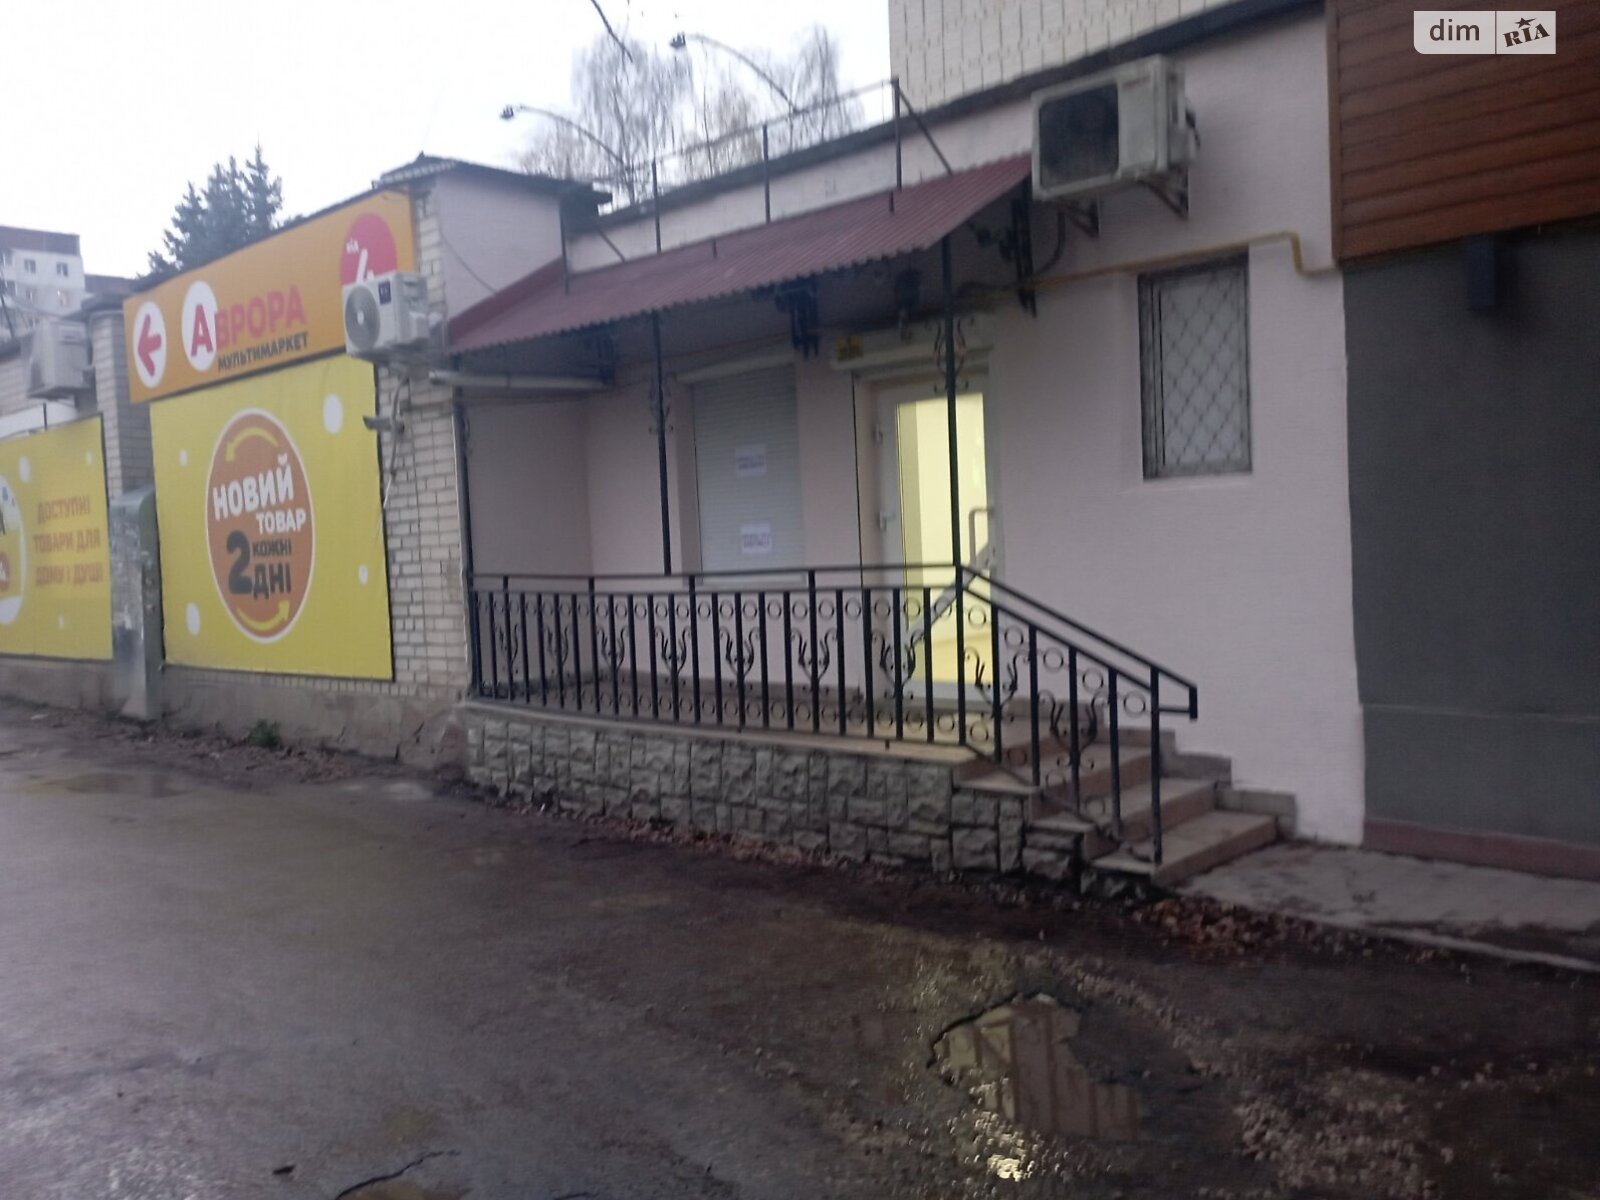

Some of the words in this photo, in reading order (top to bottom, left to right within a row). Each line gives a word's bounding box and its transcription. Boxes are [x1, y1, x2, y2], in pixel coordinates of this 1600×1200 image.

[217, 331, 308, 371] МУЛЬТИМАРКЕТ
[212, 453, 294, 521] НОВИЙ
[33, 531, 74, 553] ТОВАРИ
[76, 528, 101, 553] ДЛЯ
[255, 508, 307, 535] ТОВАР
[226, 530, 253, 595] 2
[252, 538, 293, 557] КОЖНІ
[253, 562, 293, 600] ДНІ
